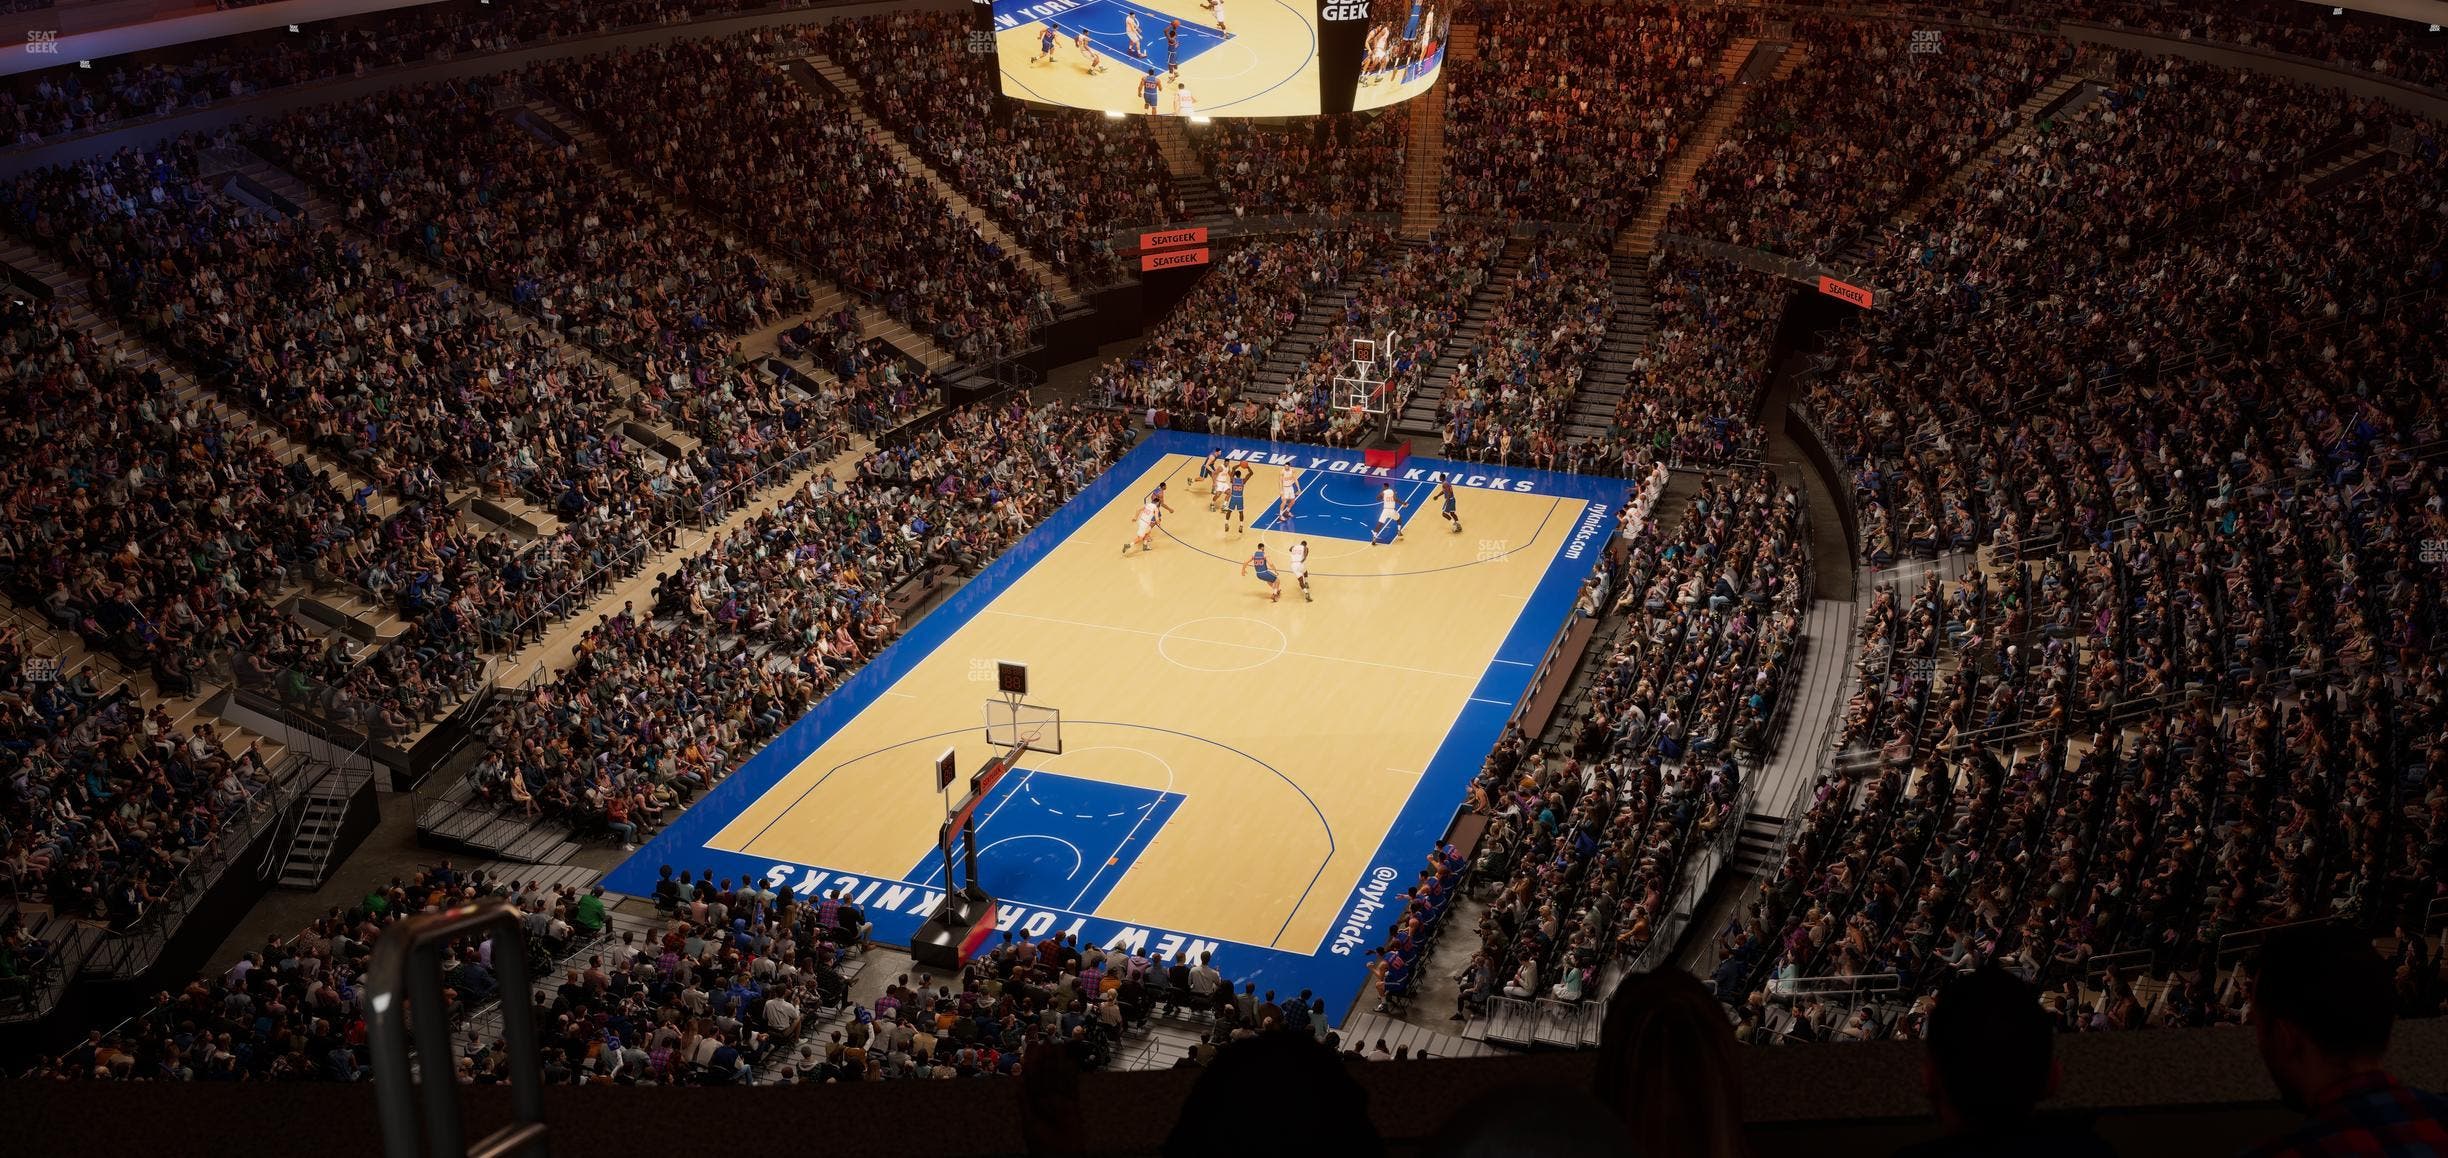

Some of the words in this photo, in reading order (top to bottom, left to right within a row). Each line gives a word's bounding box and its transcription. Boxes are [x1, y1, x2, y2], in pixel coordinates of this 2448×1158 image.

[1322, 2, 1370, 21] GEEK
[1152, 231, 1196, 246] SEATGEEK
[1153, 252, 1197, 268] SEATGEEK
[1829, 282, 1864, 304] SEATGEEK
[1225, 449, 1297, 465] NEW
[1309, 457, 1391, 477] YORK
[1403, 468, 1535, 492] KNICKS
[1564, 503, 1608, 559] nyknicks.com
[757, 864, 946, 917] KNICKS
[1330, 866, 1398, 956] @nyknicks
[1101, 926, 1219, 966] NEW
